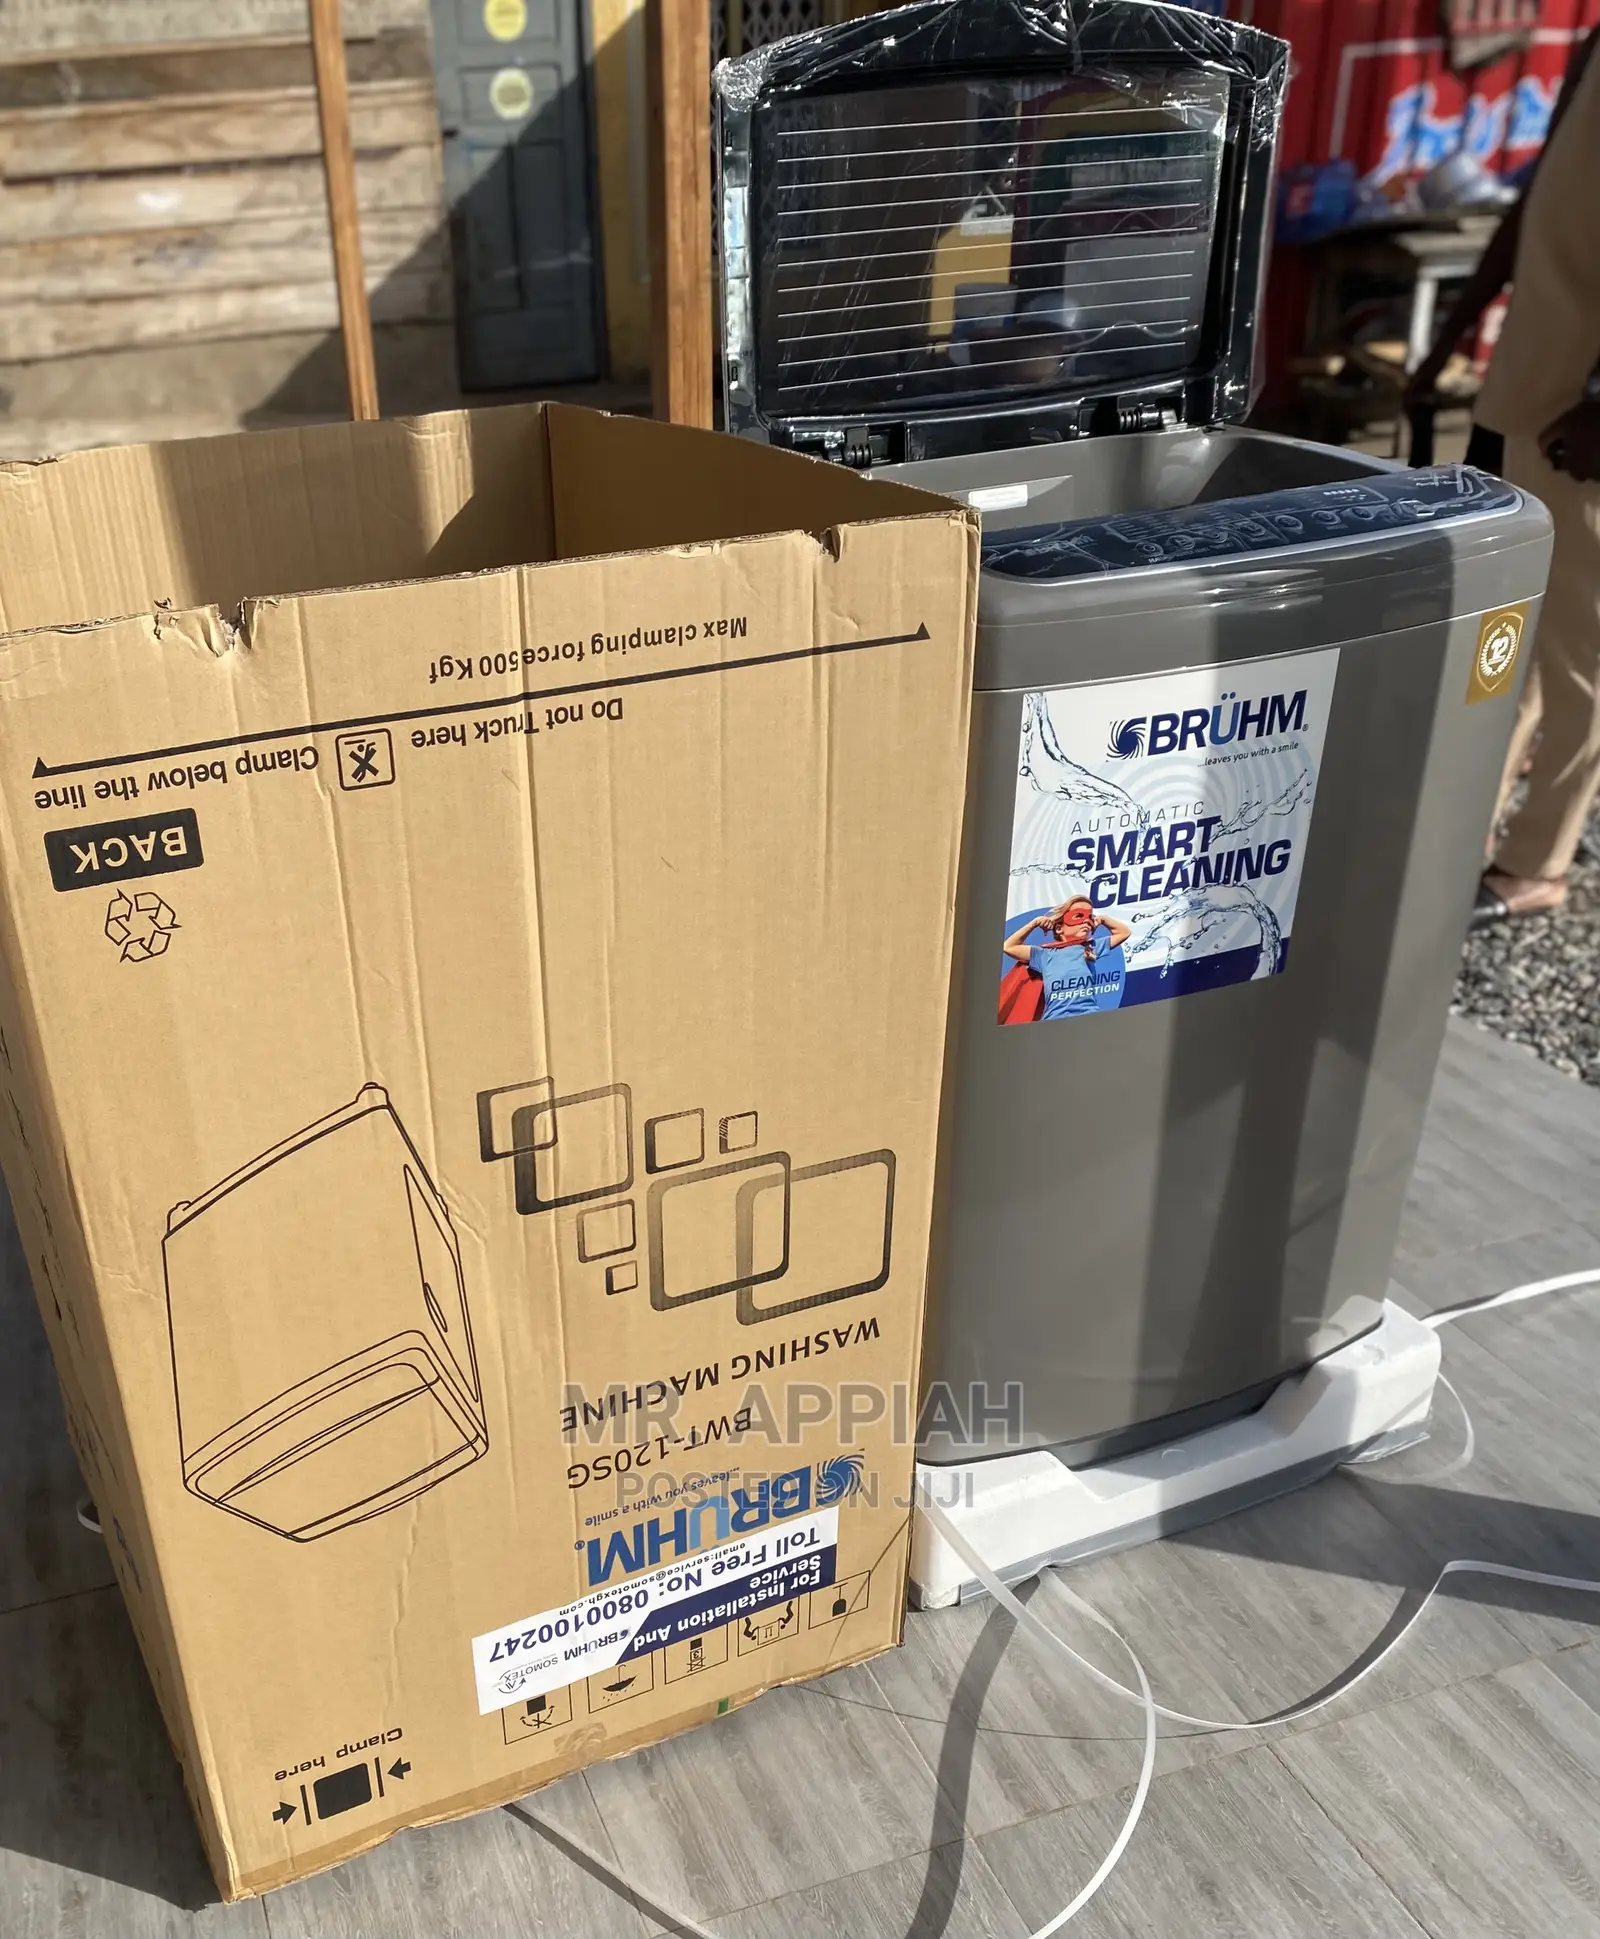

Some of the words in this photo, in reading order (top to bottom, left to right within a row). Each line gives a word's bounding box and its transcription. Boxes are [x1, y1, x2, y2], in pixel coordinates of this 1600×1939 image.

[590, 625, 698, 658] clamping
[702, 616, 748, 640] Max
[428, 656, 473, 684] Kgf
[546, 704, 584, 731] not
[591, 697, 624, 720] Do
[1147, 689, 1308, 756] BRÜHM
[411, 724, 467, 748] here
[474, 711, 540, 741] Truck
[236, 745, 320, 777] Clamp
[1233, 750, 1249, 764] you
[1251, 745, 1270, 758] with
[1278, 741, 1299, 752] smile
[94, 776, 140, 799] the
[147, 759, 228, 793] below
[33, 783, 85, 810] line
[1070, 801, 1205, 835] AUTOMATIC
[70, 825, 189, 876] BACK
[1067, 815, 1222, 874] SMART
[1089, 838, 1293, 909] CLEANING
[1050, 982, 1120, 1002] PERFECTION
[1051, 970, 1121, 992] CLEANING
[730, 1317, 881, 1381] WASHING
[559, 1362, 719, 1433] MACHINE
[567, 1406, 753, 1490] BWT-120SG
[635, 1494, 663, 1511] with
[665, 1485, 688, 1499] you
[585, 1508, 619, 1527] smile
[622, 1505, 630, 1514] a
[775, 1527, 821, 1558] Toll
[711, 1544, 767, 1576] Free
[749, 1555, 822, 1588] Service
[559, 1543, 746, 1616] email:service@somotexgh.com
[658, 1568, 703, 1597] No:
[791, 1569, 821, 1591] For
[677, 1582, 785, 1632] Installation
[489, 1589, 649, 1663] 0800100247
[633, 1625, 672, 1652] And
[504, 1657, 559, 1682] SOMOTEX
[336, 1727, 403, 1759] Clamp
[274, 1756, 326, 1781] here
